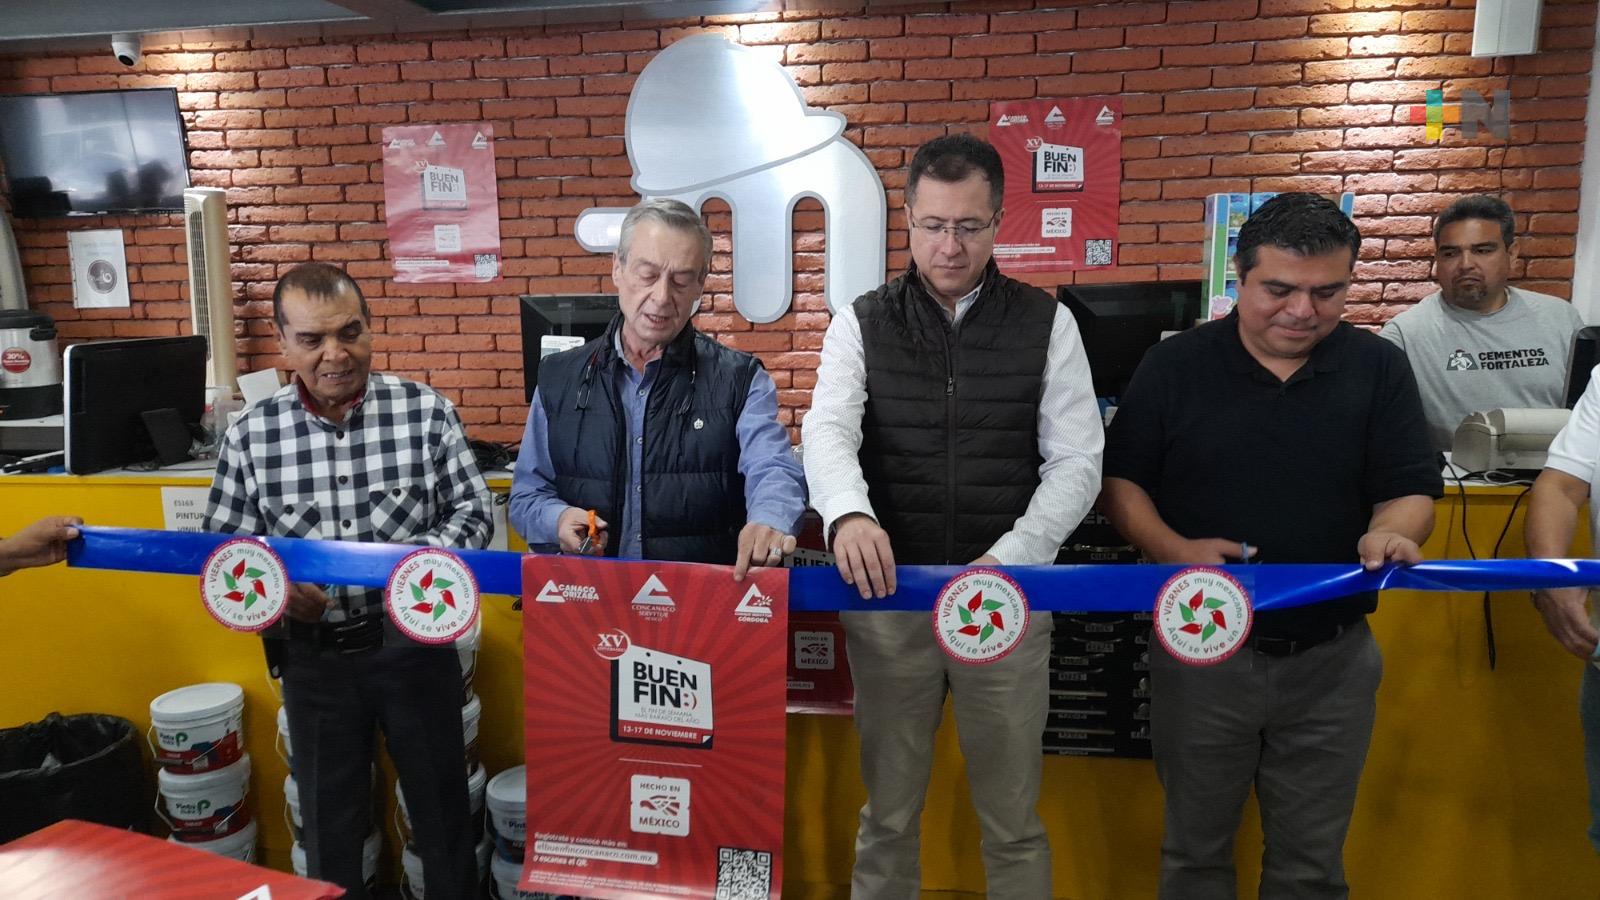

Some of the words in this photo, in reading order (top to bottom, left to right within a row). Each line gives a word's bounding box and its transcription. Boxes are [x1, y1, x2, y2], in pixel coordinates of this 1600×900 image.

[1043, 151, 1077, 162] BUEN
[429, 171, 459, 183] BUEN
[1478, 348, 1545, 361] CEMENTOS
[1481, 357, 1550, 371] FORTALEZA
[209, 549, 234, 583] VIERNES
[236, 548, 256, 557] muy
[256, 551, 280, 589] mexicano
[395, 560, 421, 595] VIERNES
[423, 558, 443, 568] muy
[444, 561, 470, 599] mexicano
[558, 584, 596, 594] CANACO
[562, 590, 600, 600] ORIZABA
[942, 581, 969, 618] VIERNES
[972, 579, 994, 589] muy
[994, 582, 1020, 620] mexicano
[1163, 579, 1190, 616] VIERNES
[1193, 577, 1214, 587] muy
[1215, 581, 1243, 619] mexicano
[232, 612, 244, 621] se
[246, 609, 267, 622] vive
[267, 599, 278, 611] un
[631, 604, 676, 612] CONCANACO
[420, 623, 433, 632] se
[435, 620, 457, 632] vive
[457, 609, 468, 621] un
[597, 633, 625, 648] XV
[966, 646, 978, 655] se
[980, 642, 1004, 654] vive
[1003, 630, 1016, 643] un
[1188, 645, 1200, 654] se
[1203, 641, 1226, 654] vive
[1226, 629, 1240, 643] un
[633, 661, 698, 691] BUEN
[623, 725, 643, 734] 13-17
[643, 727, 654, 735] DE
[655, 729, 698, 739] NOVIEMBRE
[639, 782, 668, 792] HECHO
[669, 784, 681, 793] EN
[638, 815, 681, 829] MÉXICO
